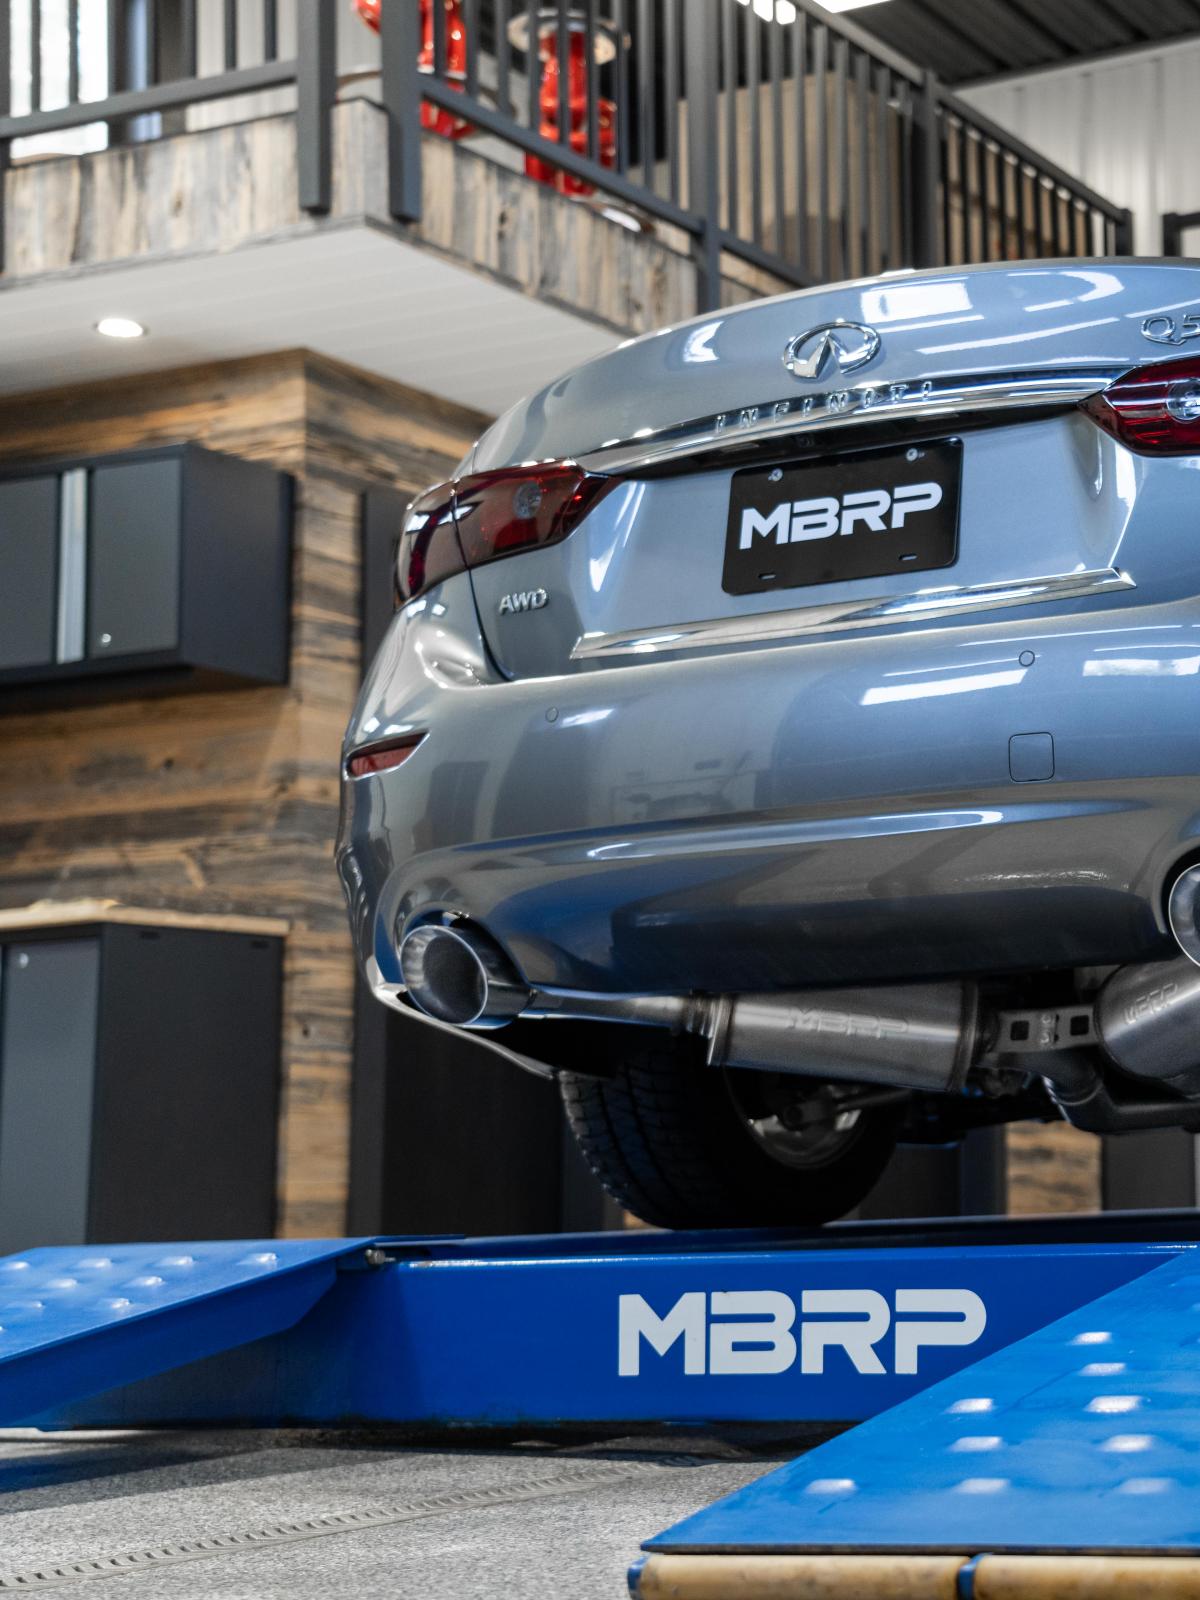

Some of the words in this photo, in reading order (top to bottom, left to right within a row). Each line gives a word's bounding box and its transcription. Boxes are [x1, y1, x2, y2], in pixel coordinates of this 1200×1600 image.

[716, 380, 932, 434] INFINITI
[739, 482, 943, 550] MBRP
[499, 588, 547, 613] AWD
[618, 1288, 987, 1376] MBRP
